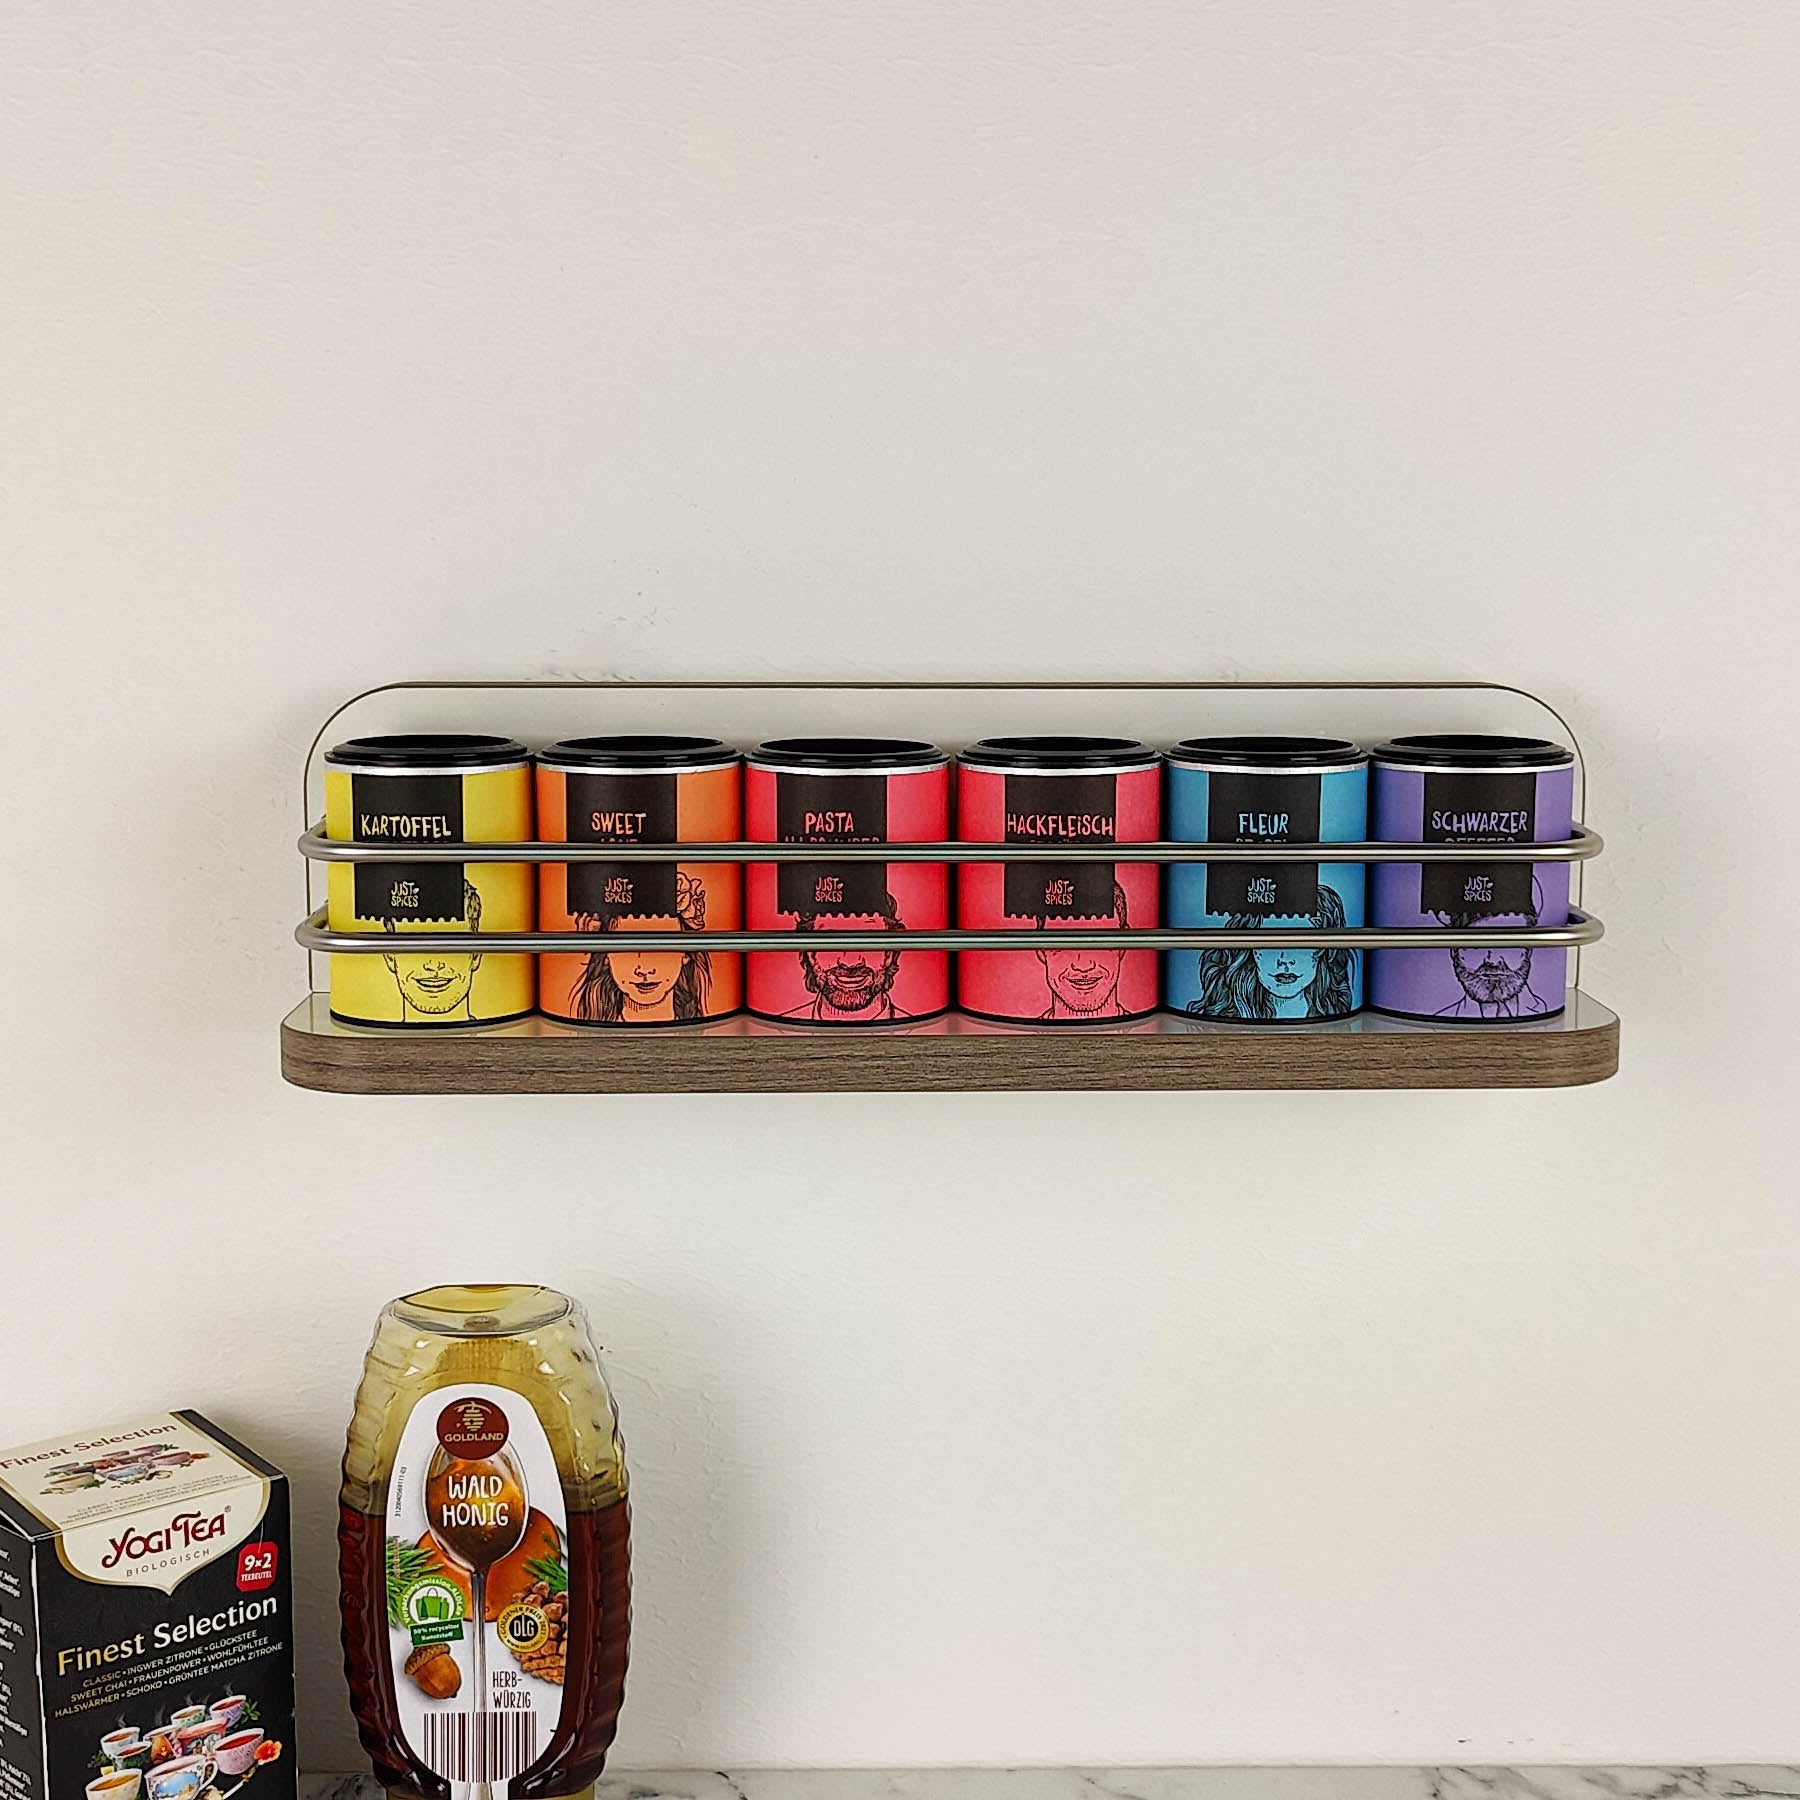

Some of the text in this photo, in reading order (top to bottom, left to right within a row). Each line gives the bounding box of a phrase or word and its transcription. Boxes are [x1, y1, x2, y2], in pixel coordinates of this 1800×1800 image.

[360, 813, 452, 839] KARTOFFEL
[591, 812, 647, 835] SWEET
[805, 811, 855, 834] PASTA
[1007, 813, 1114, 837] HACKFLEISCH
[1238, 812, 1289, 836] FLEUR
[1431, 810, 1528, 834] SCHWARZER
[390, 881, 415, 896] JUST
[604, 877, 629, 892] JUST
[815, 876, 840, 891] JUST
[1045, 879, 1070, 894] JUST
[1247, 877, 1272, 892] JUST
[1464, 875, 1489, 890] JUST
[390, 895, 419, 908] SPICES
[604, 891, 633, 904] SPICES
[815, 890, 843, 903] SPICES
[1044, 892, 1073, 906] SPICES
[1247, 890, 1276, 904] SPICES
[1463, 889, 1492, 902] SPICES
[0, 1423, 178, 1469] Finest Selection
[444, 1432, 505, 1442] GOLDLAND
[448, 1474, 503, 1500] WALD
[442, 1502, 509, 1528] HONIG
[101, 1527, 172, 1569] YOGI
[126, 1548, 211, 1577] BIOLOGISCH
[57, 1633, 146, 1676] Finest
[153, 1596, 278, 1649] Selection
[513, 1614, 535, 1637] DLG
[70, 1636, 270, 1703] SWEET CHAI FRAUENPOWER WOHLFÜHLTEE
[82, 1629, 258, 1688] CLASSIC INGWER ZITRONE GLÜCKSTEE
[54, 1641, 284, 1718] HALSWÄRMER SCHOKO GRÜNTEE MATCHA ZITRONE
[492, 1670, 523, 1688] HERB-
[492, 1689, 532, 1709] WÜRZIG
